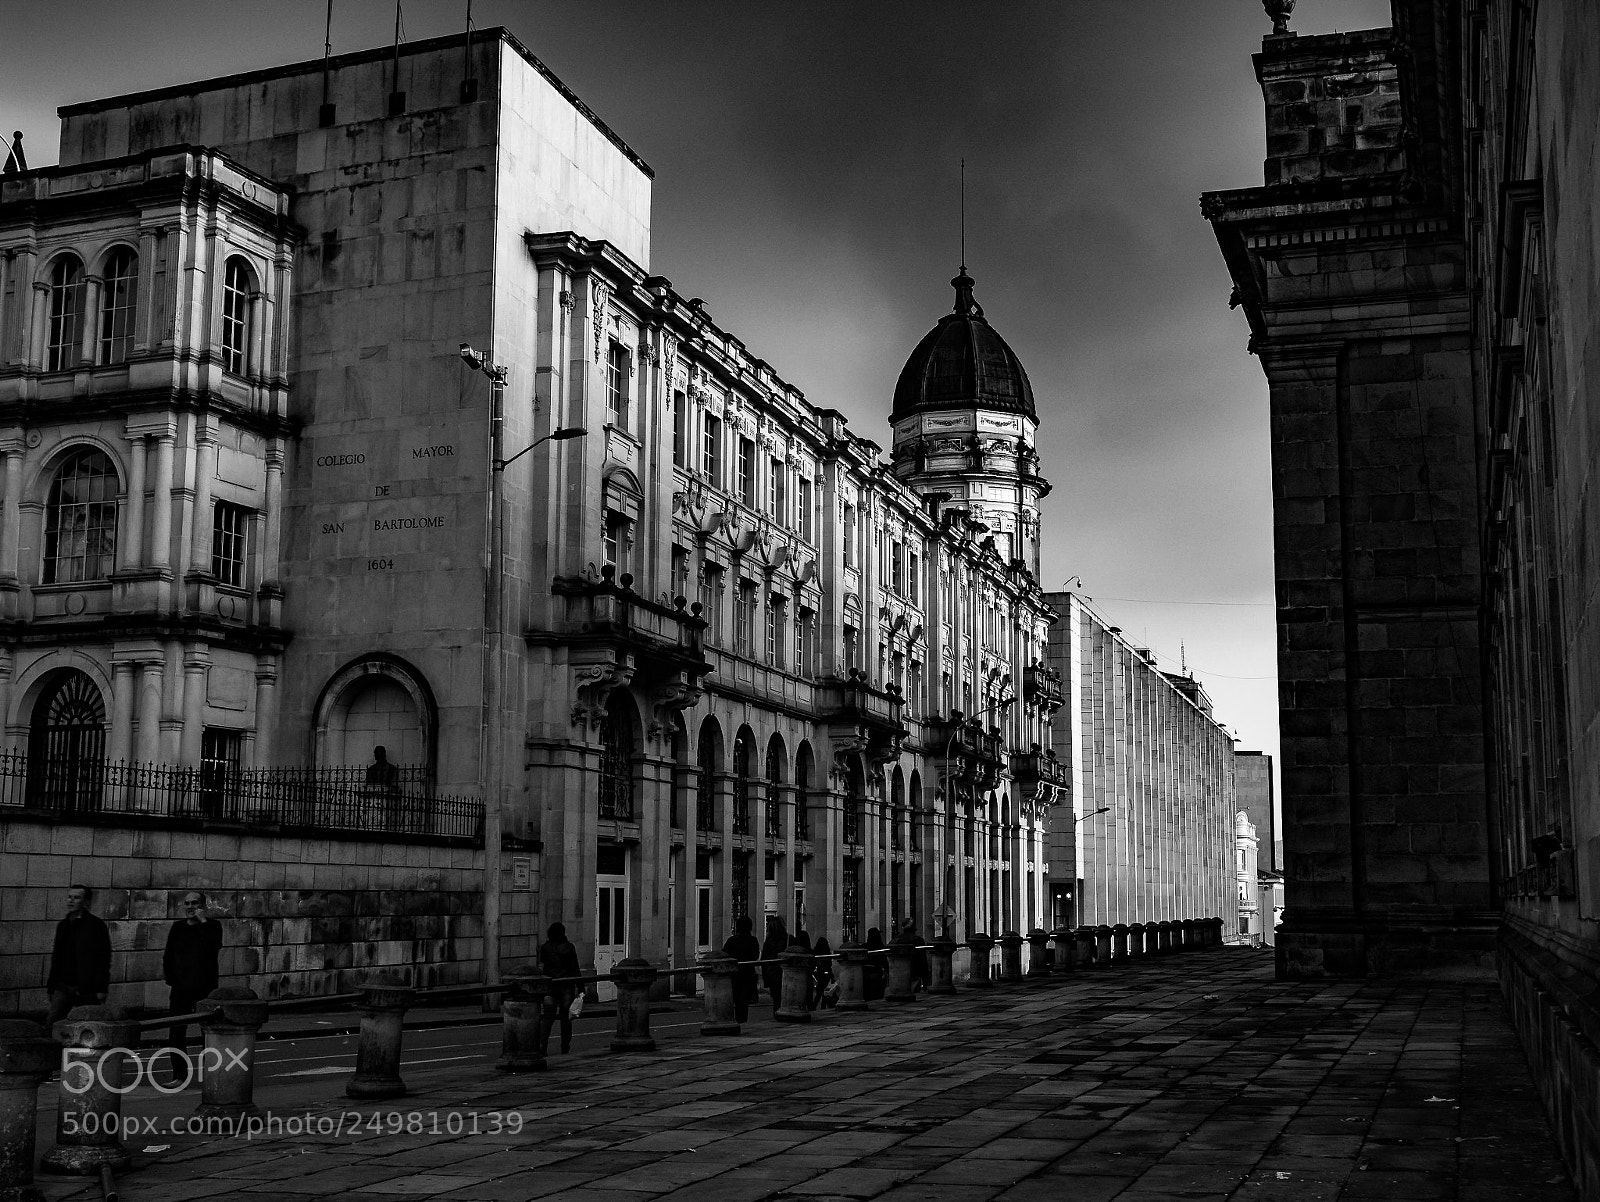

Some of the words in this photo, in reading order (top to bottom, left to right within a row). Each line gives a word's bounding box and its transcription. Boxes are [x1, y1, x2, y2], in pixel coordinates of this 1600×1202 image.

[317, 454, 365, 467] COLEGIO
[412, 445, 454, 459] MAYOR
[375, 486, 390, 496] DE
[322, 523, 344, 534] SAN
[374, 516, 444, 531] BARTOLOME
[367, 559, 393, 570] 1604
